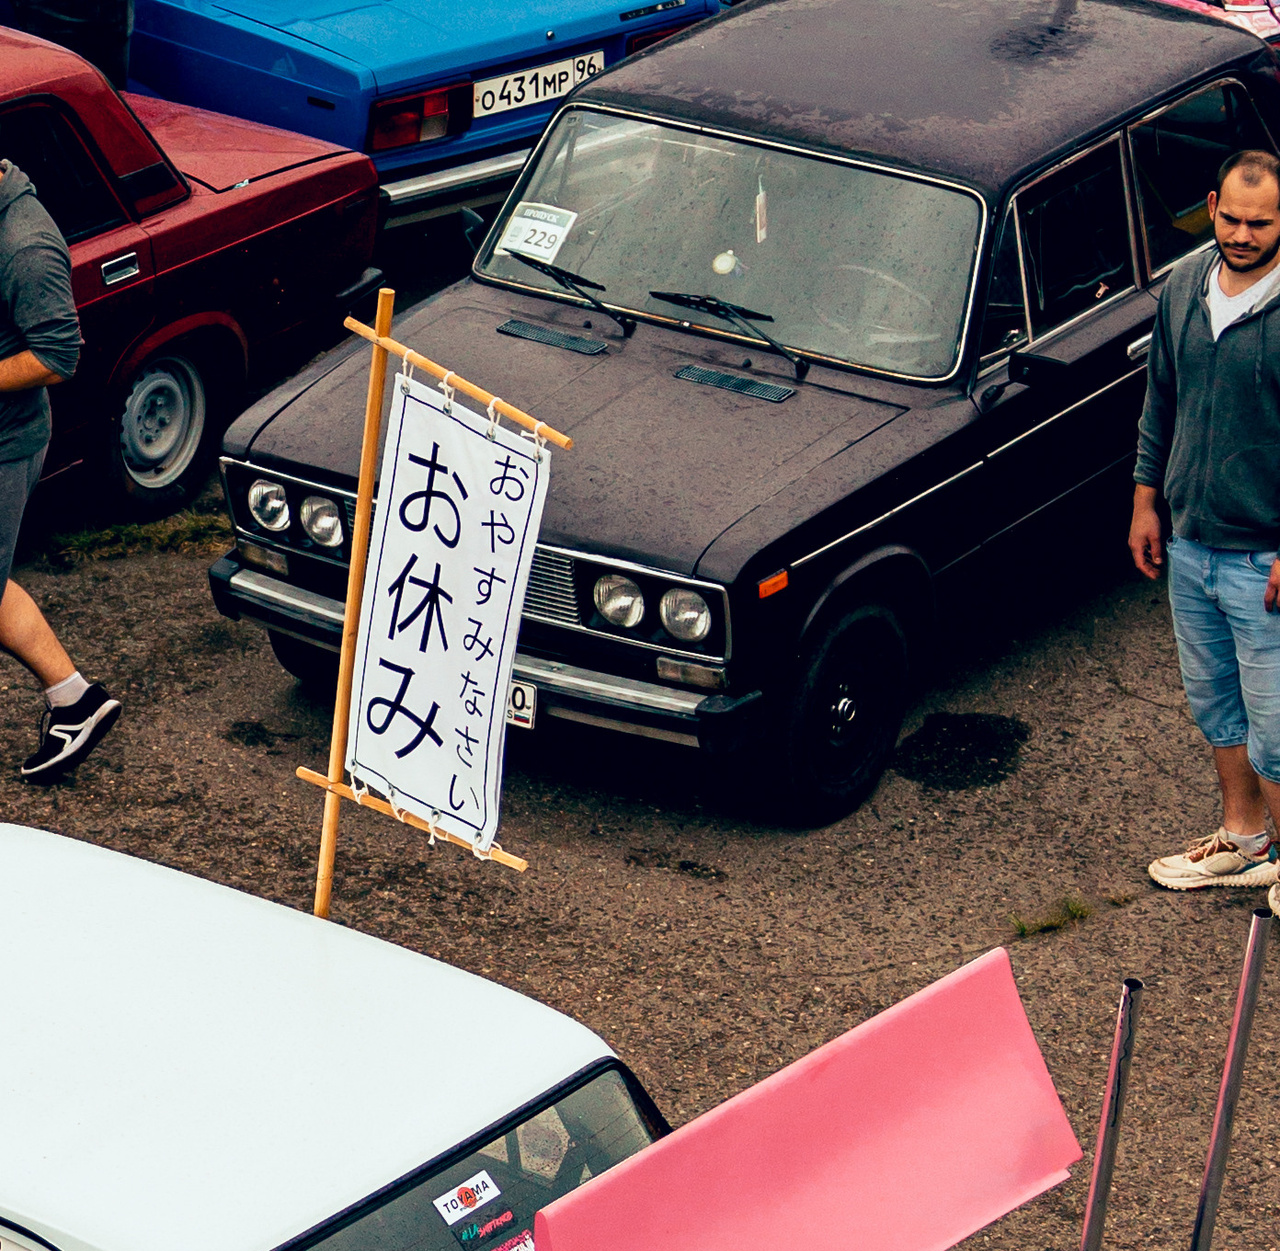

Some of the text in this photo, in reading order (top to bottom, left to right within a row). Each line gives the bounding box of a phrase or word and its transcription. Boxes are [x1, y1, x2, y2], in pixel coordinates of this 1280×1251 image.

[482, 56, 597, 110] О431МР 96
[524, 228, 558, 249] 229
[365, 441, 468, 759] お休み
[448, 455, 530, 811] おやすみなさい
[507, 686, 526, 711] 0
[442, 1180, 490, 1214] TOYAMA
